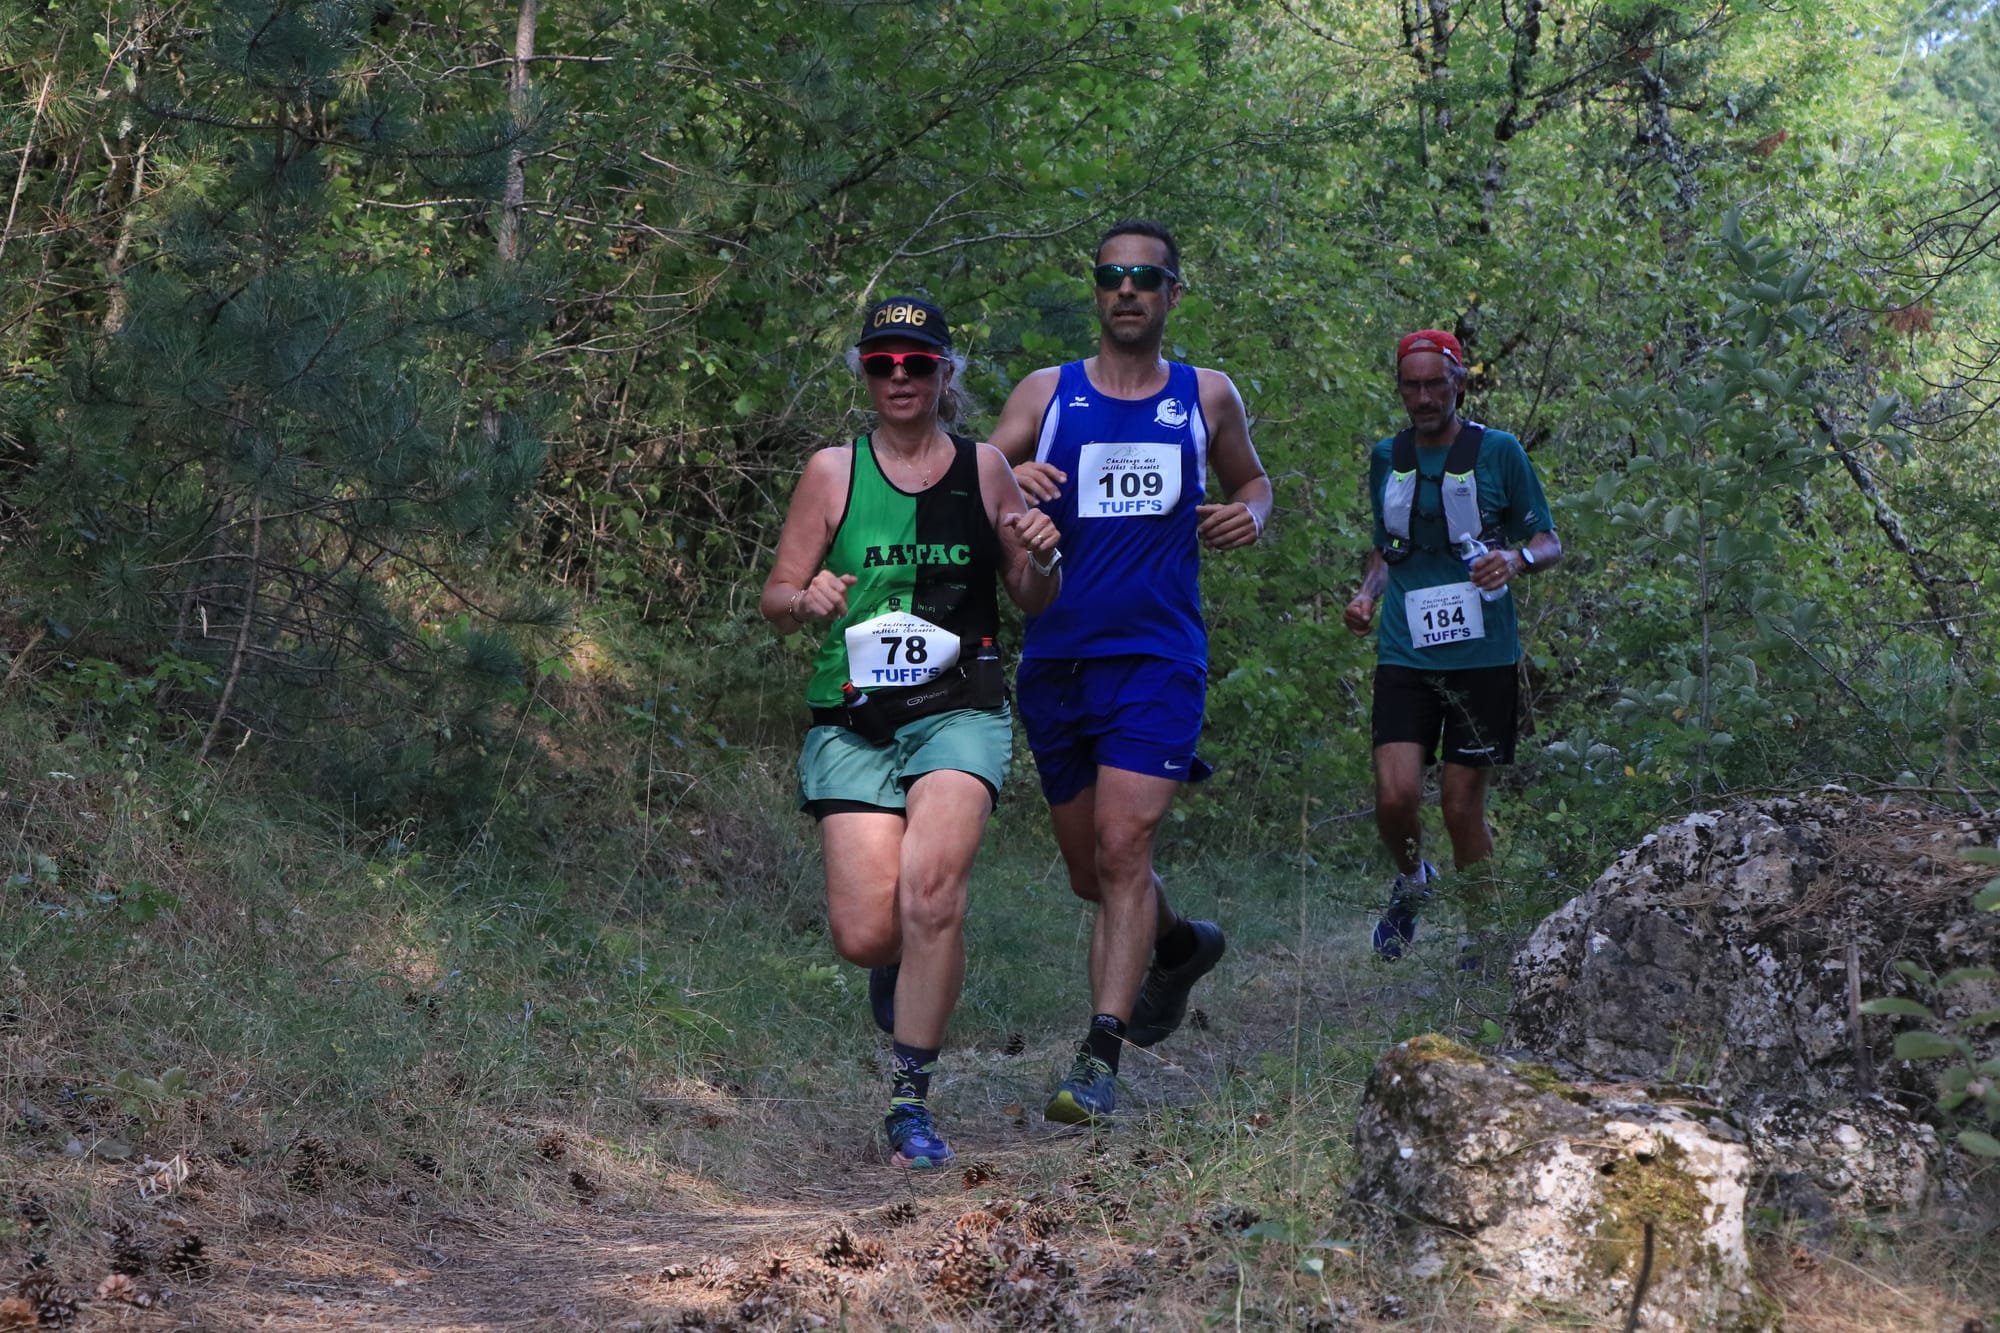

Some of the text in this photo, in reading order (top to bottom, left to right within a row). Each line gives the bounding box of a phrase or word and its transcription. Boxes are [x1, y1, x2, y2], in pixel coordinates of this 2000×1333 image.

[873, 304, 928, 328] ciele
[1098, 472, 1163, 498] 109
[1098, 499, 1163, 513] TUFF'S
[863, 544, 971, 569] AATAC
[1423, 606, 1465, 630] 184
[1423, 627, 1471, 644] TUFF'S
[880, 635, 928, 665] 78
[871, 667, 941, 683] TUFF'S
